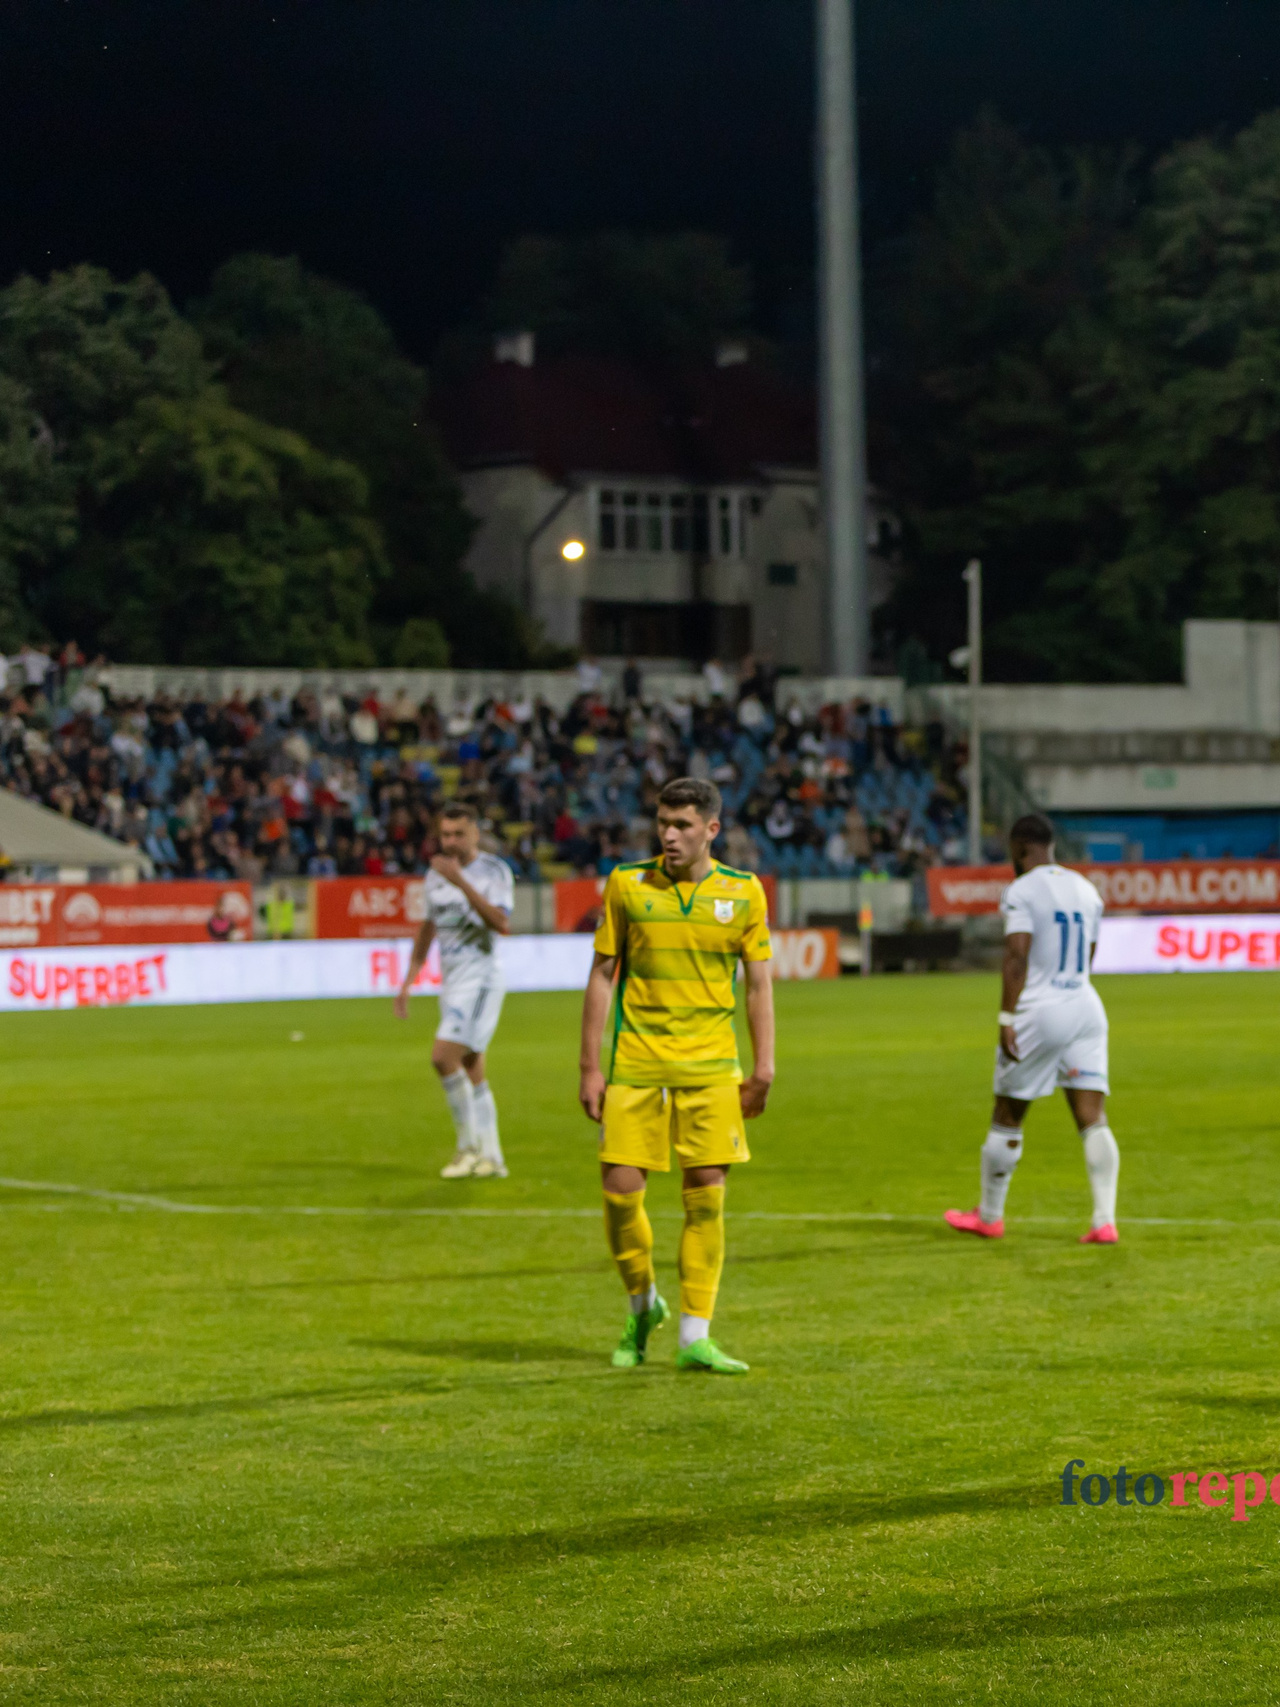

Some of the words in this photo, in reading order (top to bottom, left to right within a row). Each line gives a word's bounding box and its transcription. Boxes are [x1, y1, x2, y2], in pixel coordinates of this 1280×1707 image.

[1089, 868, 1277, 903] RODALCOM
[1054, 911, 1085, 974] 11
[9, 954, 166, 1006] SUPERBET
[371, 951, 398, 987] FI
